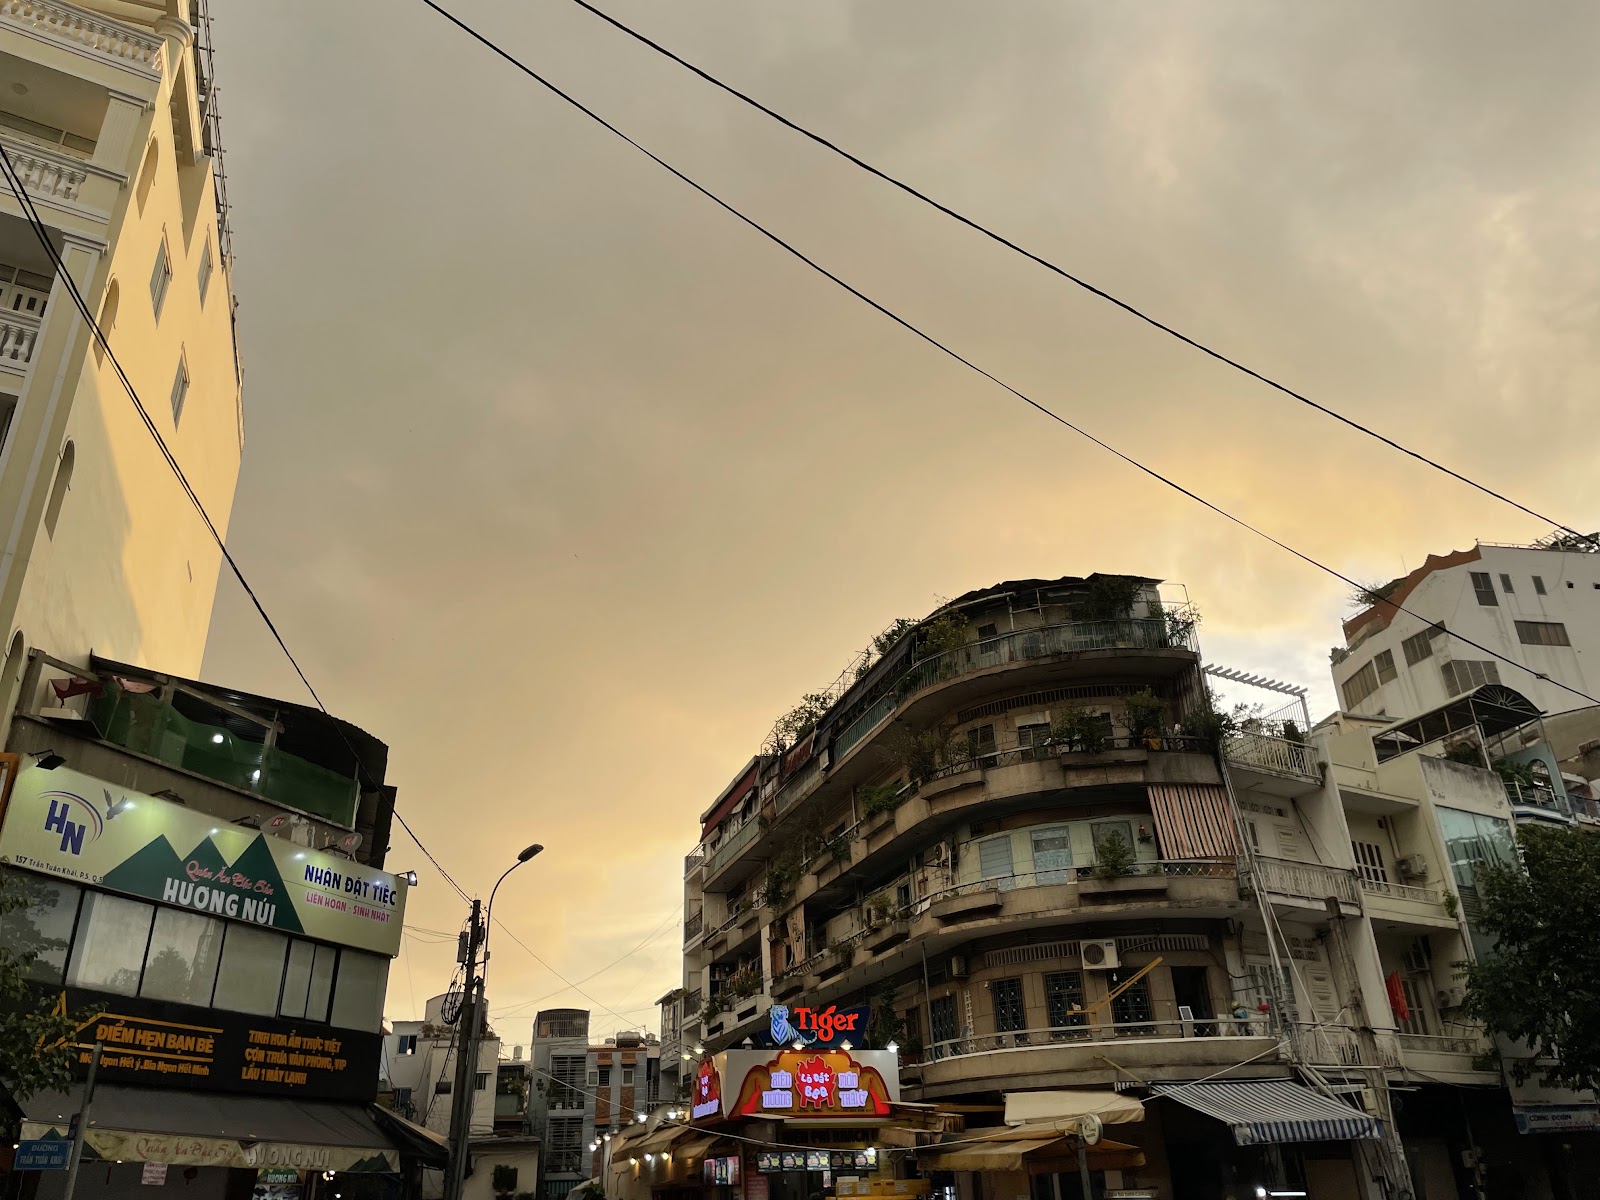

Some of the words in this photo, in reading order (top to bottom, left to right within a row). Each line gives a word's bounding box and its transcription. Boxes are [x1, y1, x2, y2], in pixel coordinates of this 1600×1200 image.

[15, 855, 28, 864] 157
[304, 864, 342, 890] NHẬN
[344, 876, 370, 899] ĐẶT
[372, 885, 397, 907] TIỆC
[162, 877, 240, 917] HƯƠNG
[241, 897, 276, 926] NÚI
[306, 891, 324, 905] LIÊN
[353, 905, 370, 918] SINH
[95, 1020, 135, 1044] ĐIỂM
[134, 1029, 166, 1051] HẸN
[166, 1033, 196, 1054] BẠN
[196, 1034, 215, 1054] BÈ
[793, 1005, 860, 1042] Tiger
[302, 1036, 324, 1054] THỰC
[324, 1037, 342, 1056] VIỆT
[260, 1068, 265, 1081] 1
[265, 1067, 285, 1083] MÁY
[284, 1071, 308, 1087] LẠNH
[334, 1058, 348, 1071] VIP
